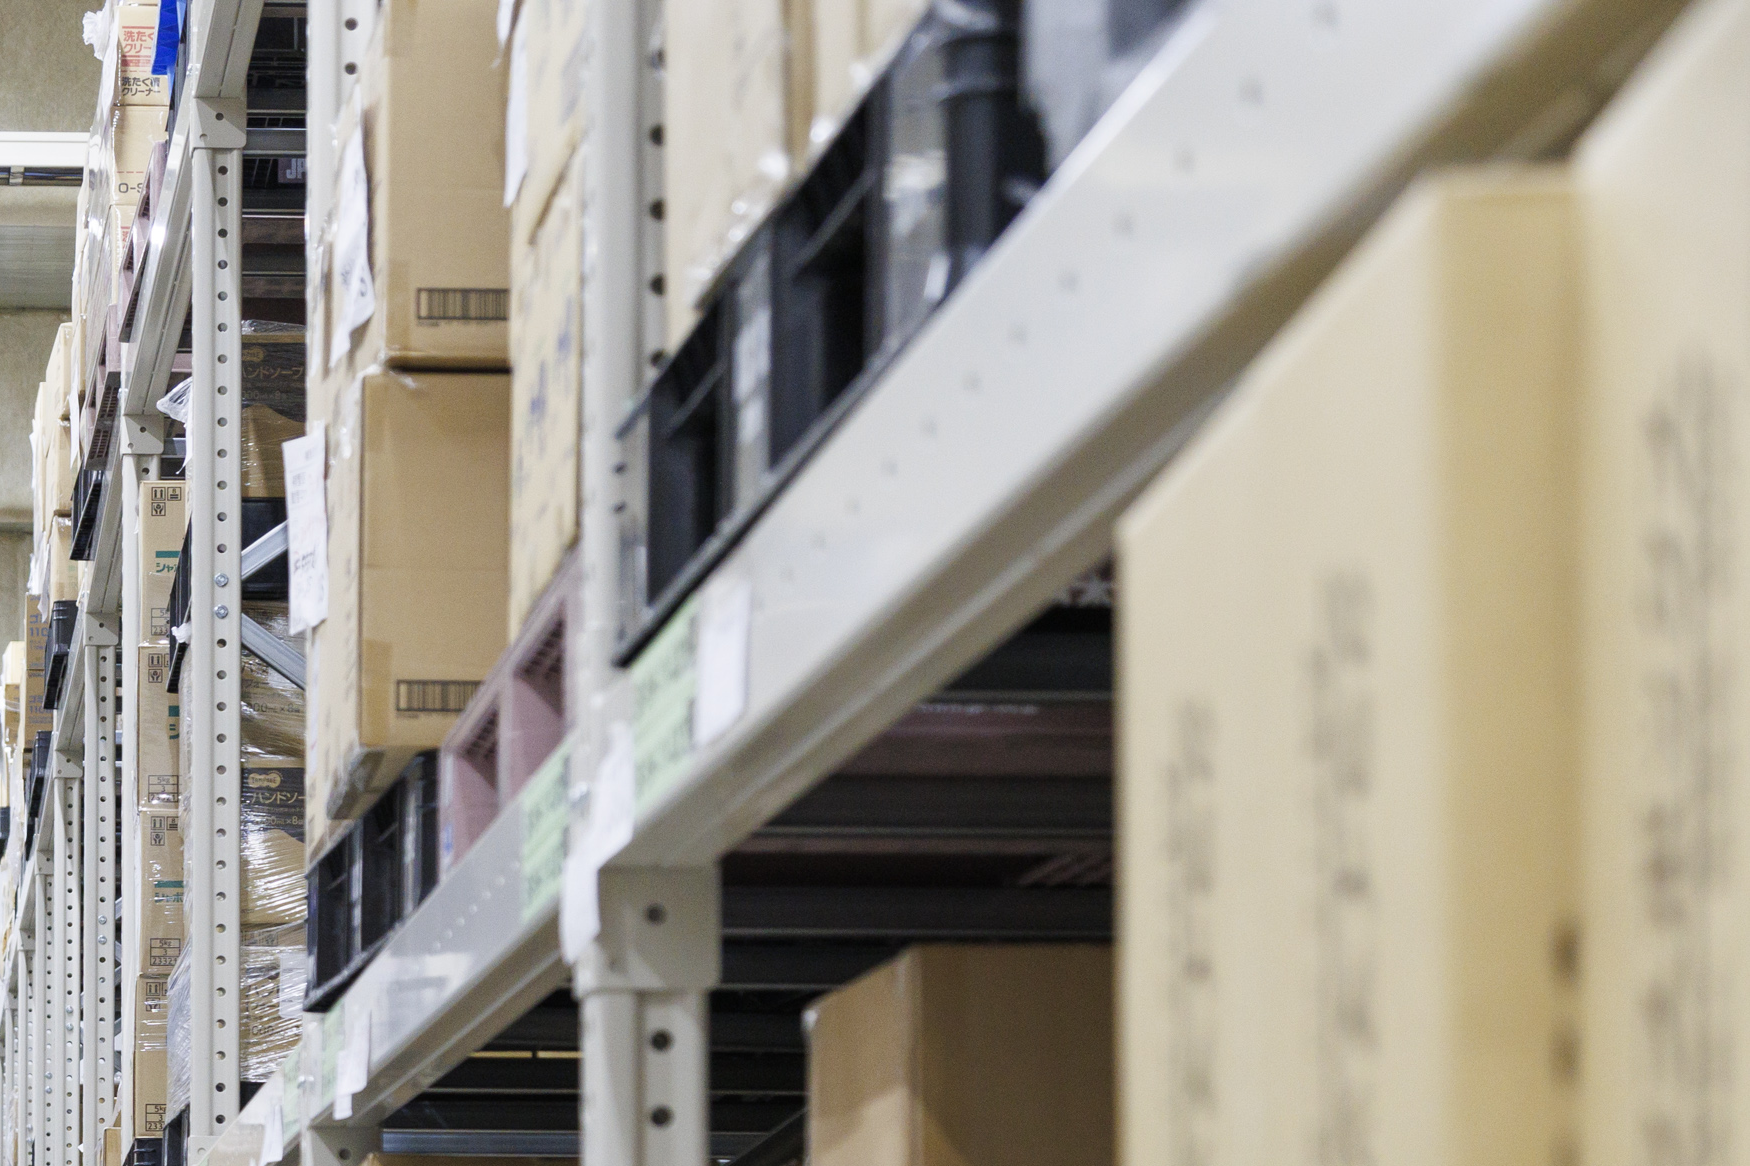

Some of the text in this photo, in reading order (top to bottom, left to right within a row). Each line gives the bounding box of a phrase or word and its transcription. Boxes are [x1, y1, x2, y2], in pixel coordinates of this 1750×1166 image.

[121, 87, 161, 97] クリーナー
